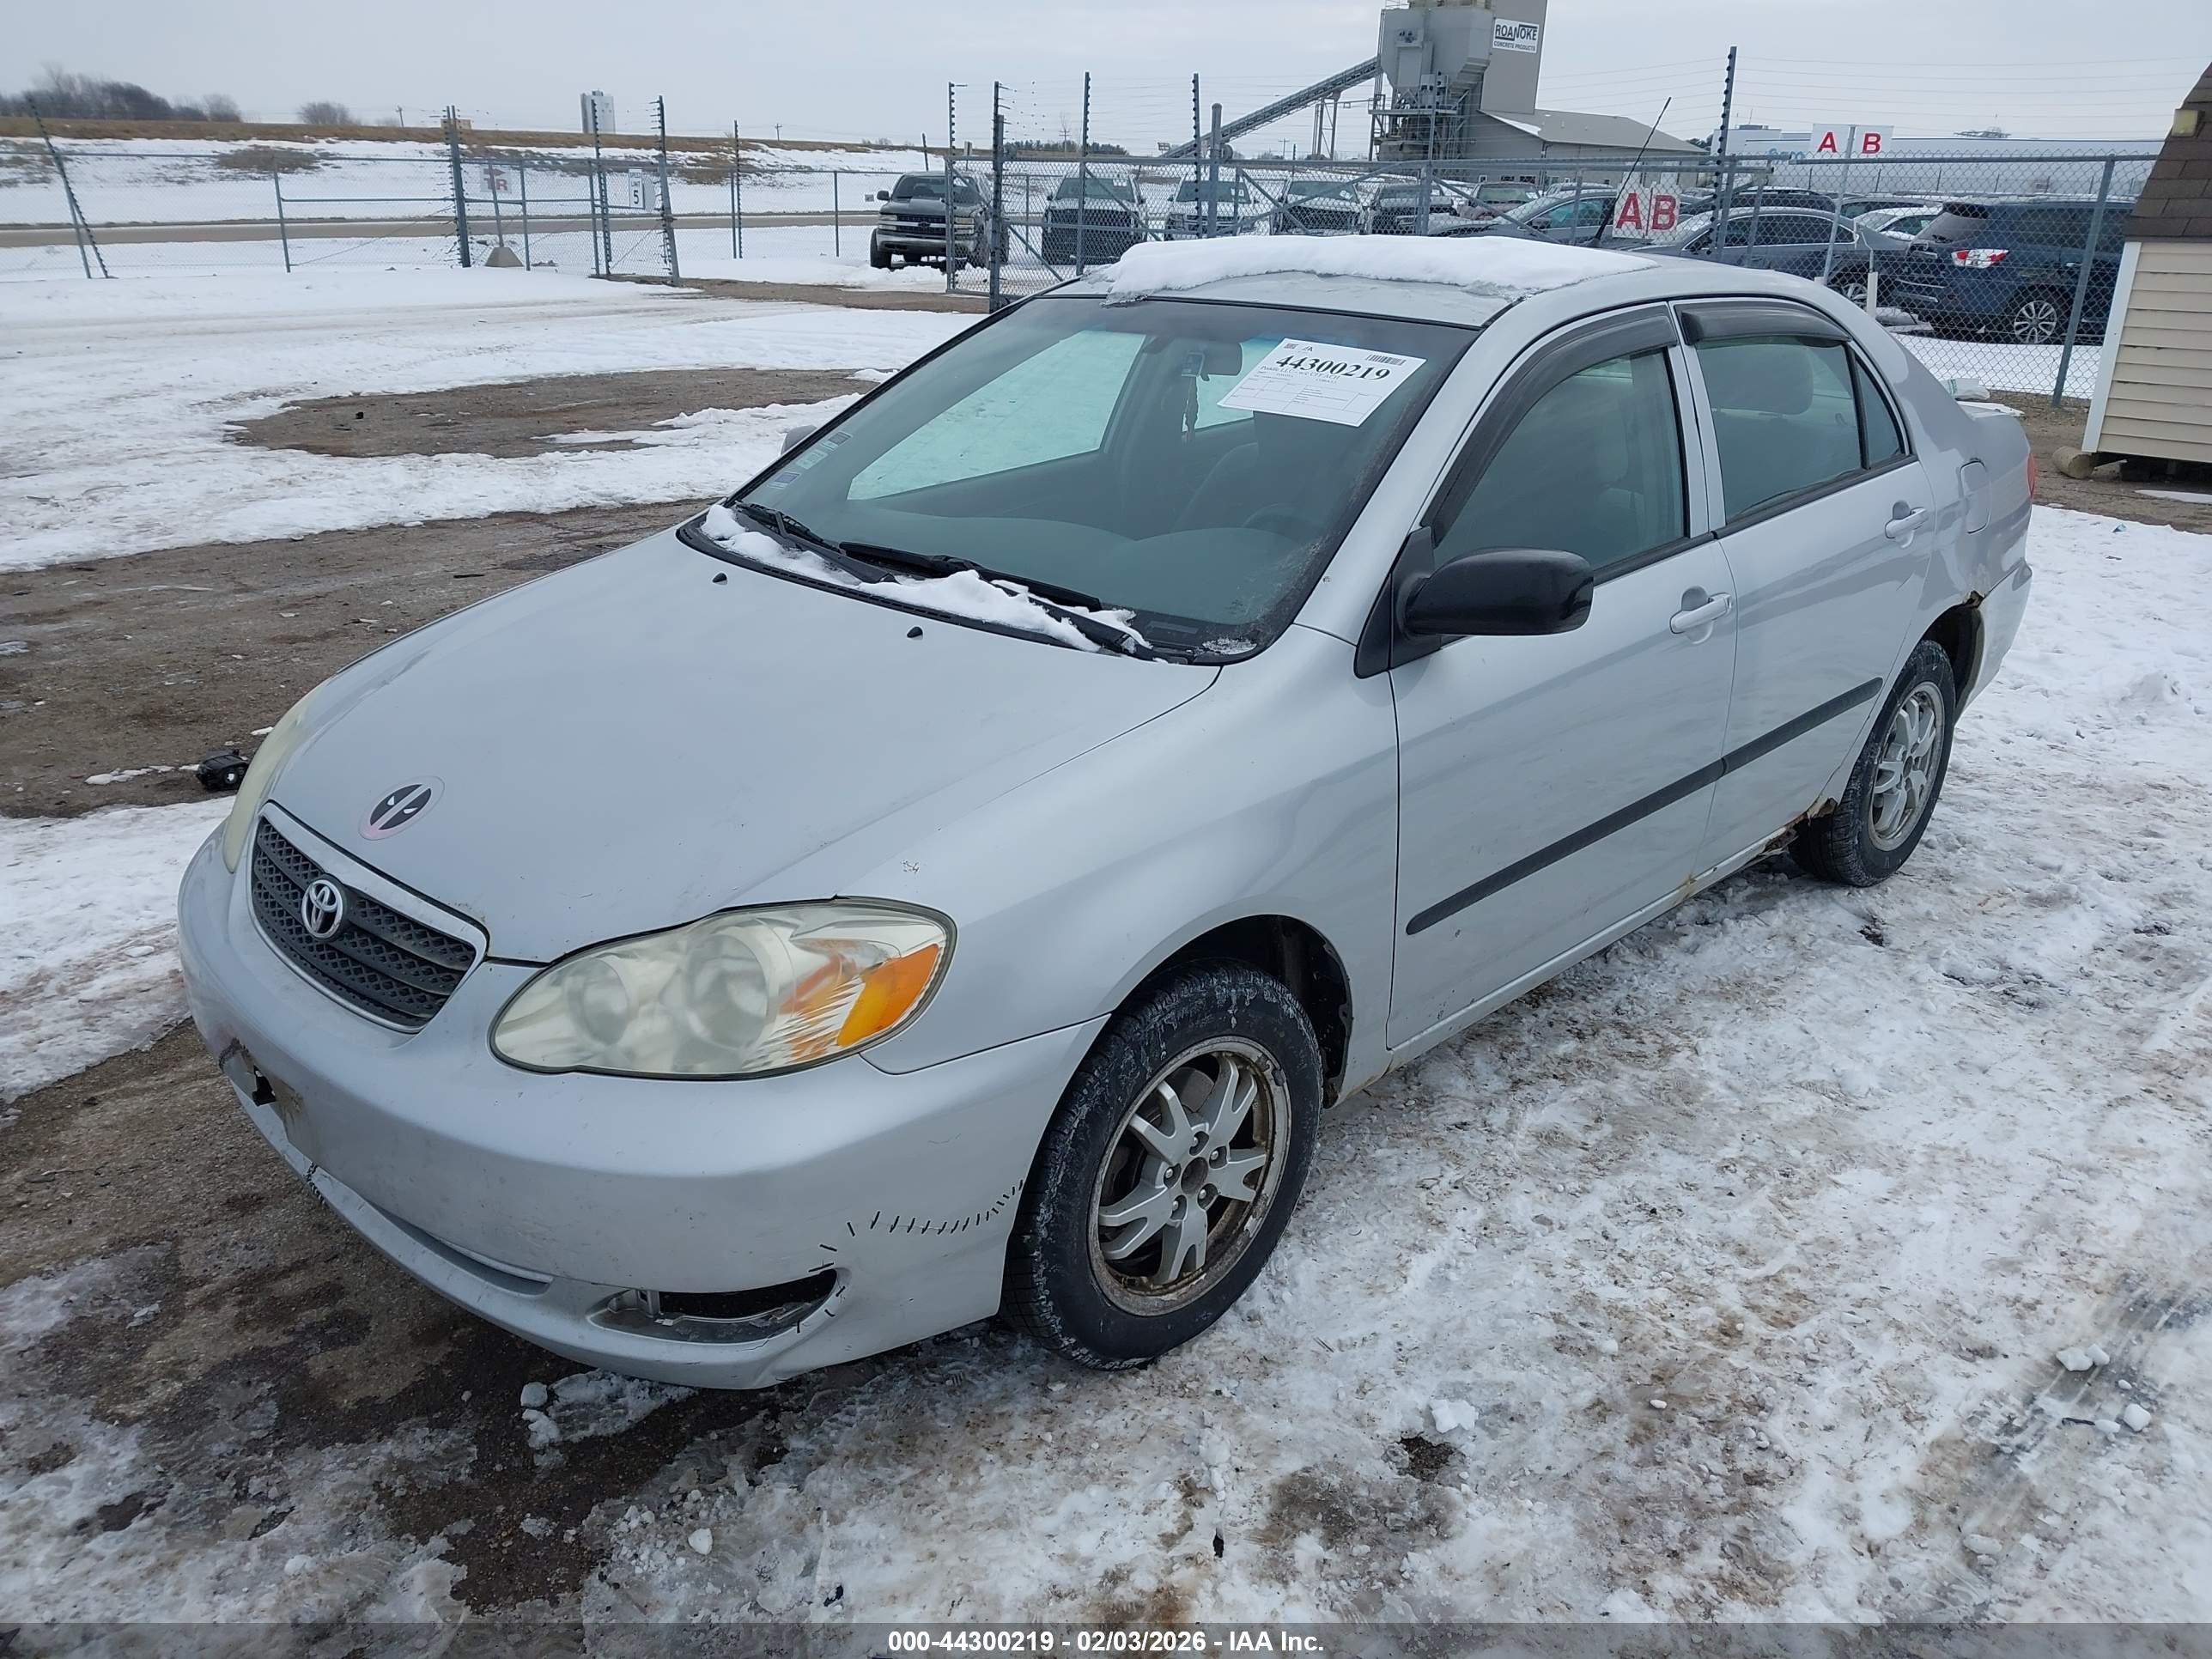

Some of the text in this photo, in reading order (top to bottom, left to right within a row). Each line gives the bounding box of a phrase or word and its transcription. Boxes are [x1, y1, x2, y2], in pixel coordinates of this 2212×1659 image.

[1495, 24, 1537, 40] ROANOKE
[1817, 131, 1881, 154] A B
[633, 190, 639, 204] 5
[1616, 192, 1676, 230] A B
[1276, 355, 1390, 380] 44300219
